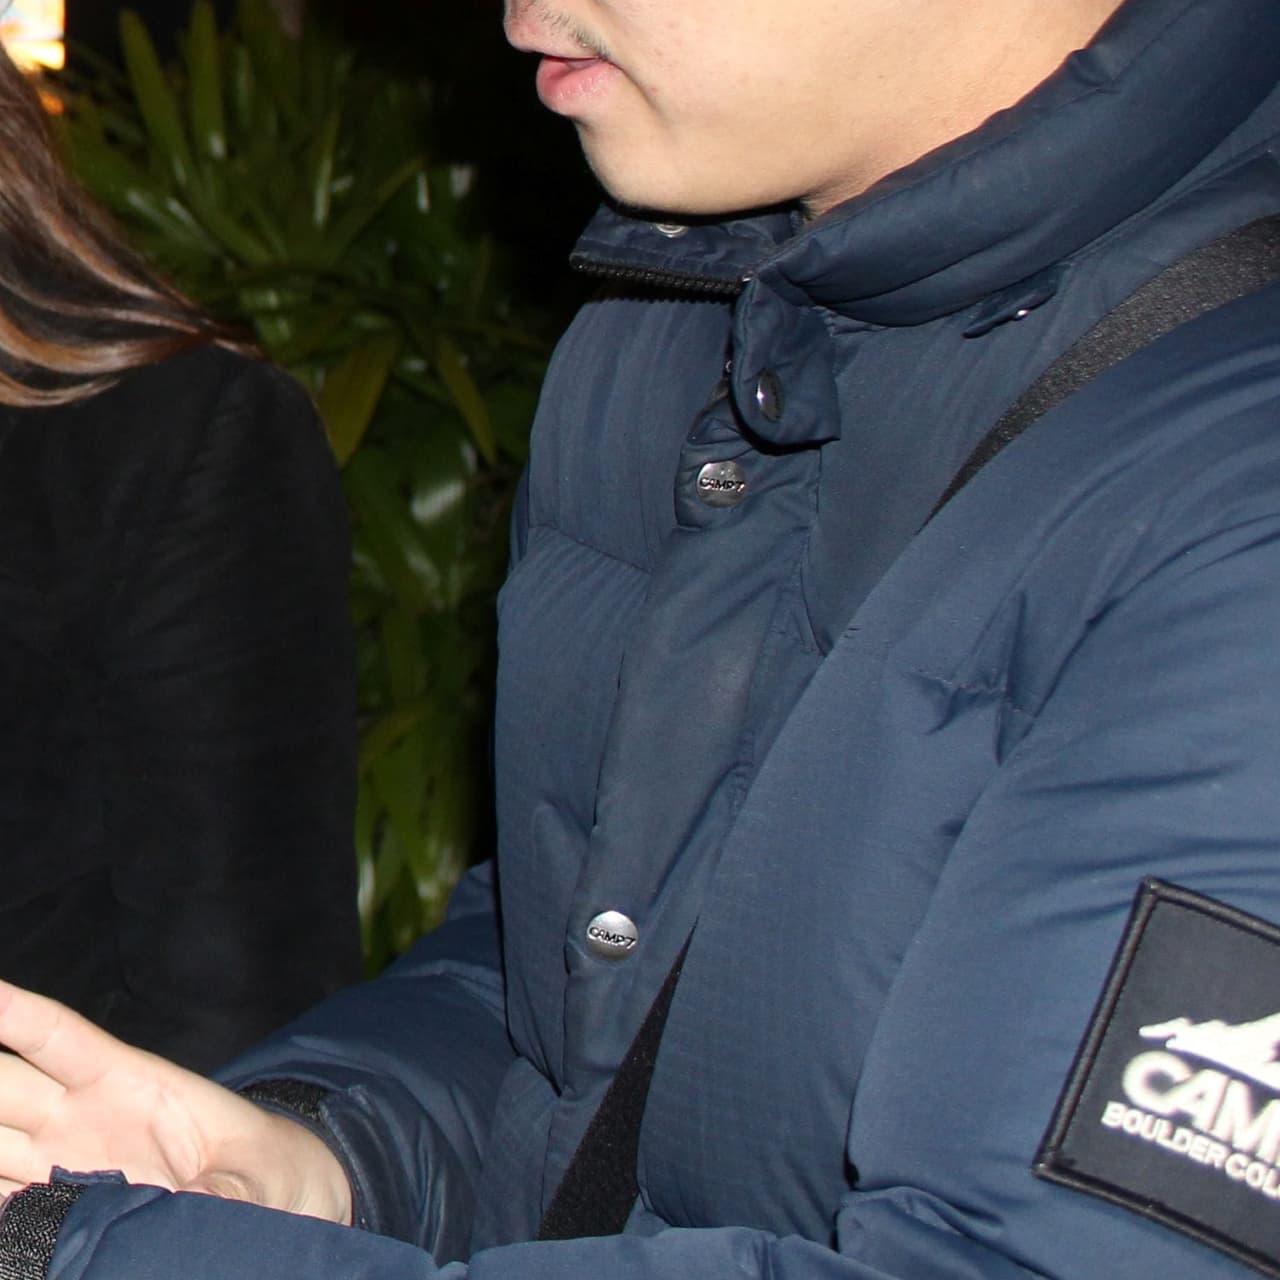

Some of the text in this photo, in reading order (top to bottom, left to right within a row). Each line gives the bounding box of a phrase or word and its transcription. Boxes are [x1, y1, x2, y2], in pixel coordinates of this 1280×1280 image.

[1101, 1100, 1280, 1199] BOULDER COL
[1122, 1050, 1280, 1164] CAM
